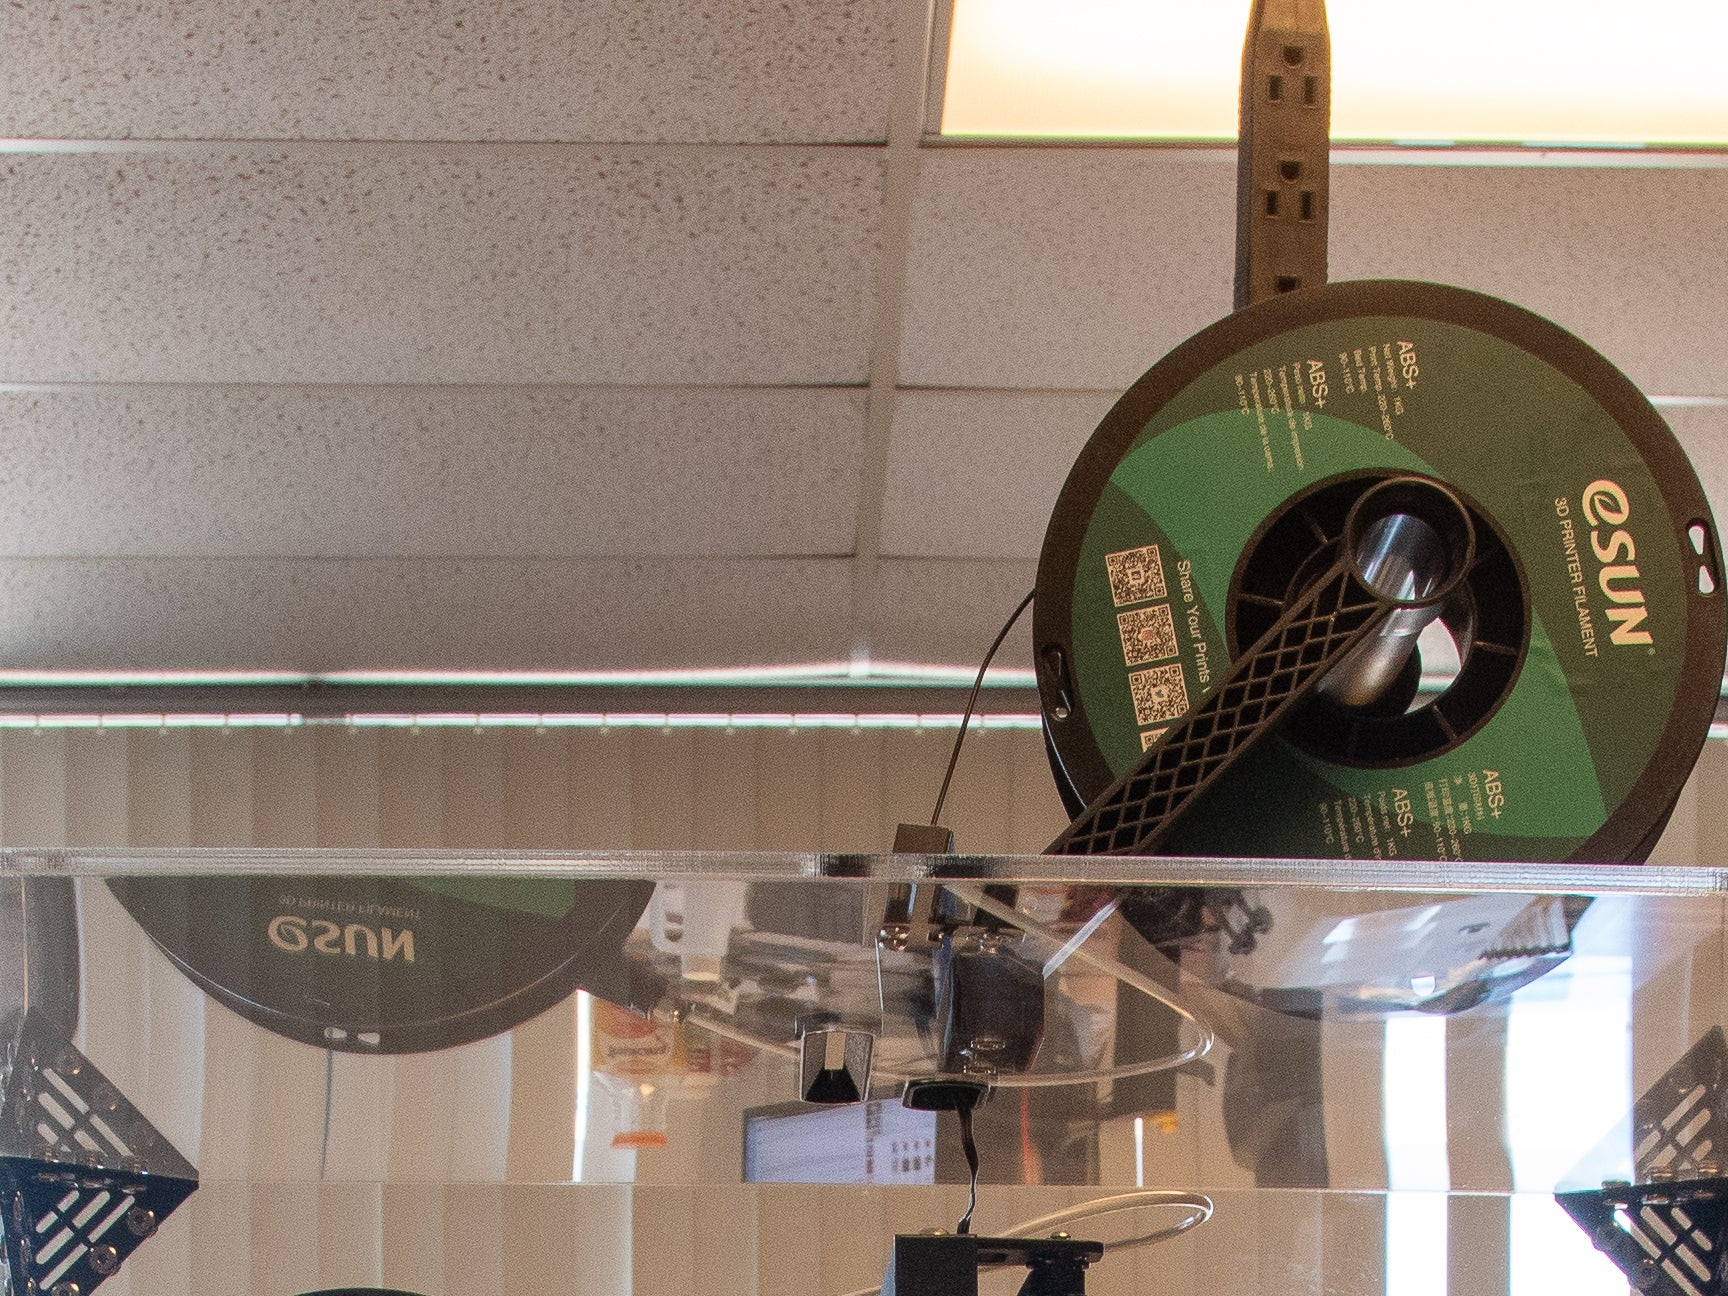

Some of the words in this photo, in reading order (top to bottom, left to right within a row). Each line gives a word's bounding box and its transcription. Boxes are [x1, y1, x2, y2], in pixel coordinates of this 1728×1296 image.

[1306, 358, 1330, 409] ABS+
[1397, 340, 1418, 390] ABS+
[1554, 497, 1569, 517] 3D
[1558, 519, 1583, 583] PRINTER
[1176, 558, 1193, 603] Share
[1185, 605, 1202, 640] Your
[1571, 585, 1599, 659] FILAMENT
[1192, 641, 1209, 683] Prints
[1391, 786, 1413, 837] ABS+
[1482, 768, 1503, 819] ABS+
[1386, 838, 1397, 856] 1KG
